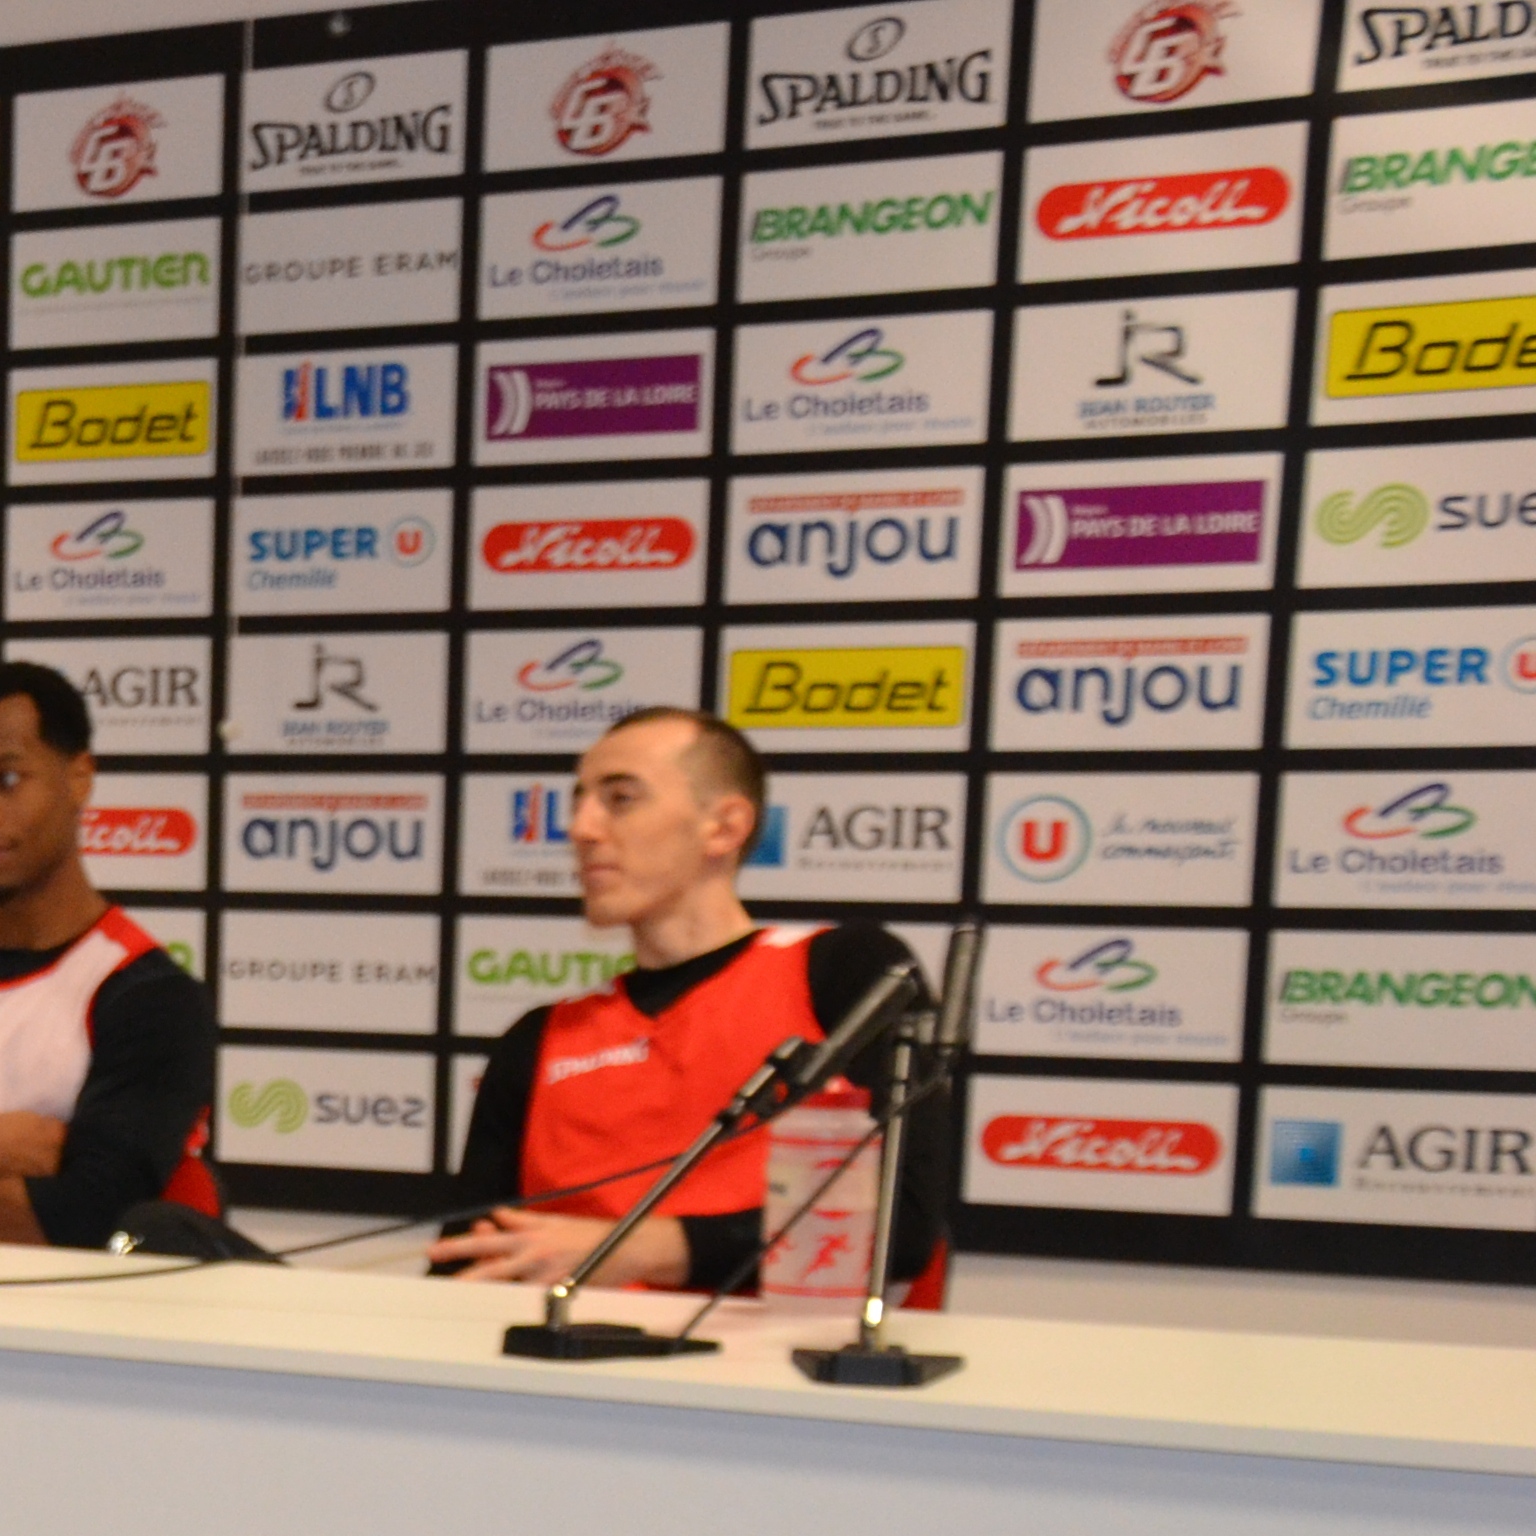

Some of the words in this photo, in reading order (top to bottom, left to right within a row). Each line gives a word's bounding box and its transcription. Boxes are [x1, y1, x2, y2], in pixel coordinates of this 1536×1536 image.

[1354, 0, 1536, 66] SPALD
[754, 48, 994, 127] SPALDING
[247, 103, 454, 173] SPALDING
[751, 189, 997, 245] BRANGEON
[1056, 178, 1270, 236] Nicoll
[19, 250, 212, 299] GAUTIER
[244, 257, 362, 286] GROUPE
[375, 249, 460, 277] ERAM
[489, 264, 525, 288] Le
[529, 254, 666, 285] Choletais
[314, 362, 411, 420] LNB
[744, 399, 780, 423] Le
[788, 391, 929, 421] Choletais
[30, 397, 202, 451] Bodet
[247, 526, 380, 564] SUPER
[394, 529, 423, 559] U
[498, 522, 680, 567] Nicoll
[747, 515, 961, 579] anjou
[1072, 517, 1126, 541] PAYS
[1128, 515, 1161, 539] DE
[1164, 513, 1193, 537] LA
[1197, 509, 1262, 536] LOIRE
[14, 571, 43, 592] Le
[50, 564, 166, 591] Choletais
[84, 666, 201, 709] AGIR
[741, 659, 952, 716] Bodet
[1311, 646, 1492, 689] SUPER
[476, 702, 509, 724] Le
[1015, 663, 1243, 726] anjou
[81, 810, 181, 852] icoll
[242, 816, 426, 872] anjou
[801, 807, 953, 852] AGIR
[1020, 819, 1069, 863] U
[1288, 849, 1331, 875] Le
[1338, 847, 1505, 876] Choletais
[228, 957, 343, 984] GROUPE
[353, 961, 437, 985] ERAM
[985, 1001, 1025, 1026] Le
[1032, 997, 1183, 1028] Choletais
[315, 1089, 426, 1129] suez
[1002, 1120, 1201, 1172] Nicoll
[1358, 1123, 1536, 1176] AGIR
